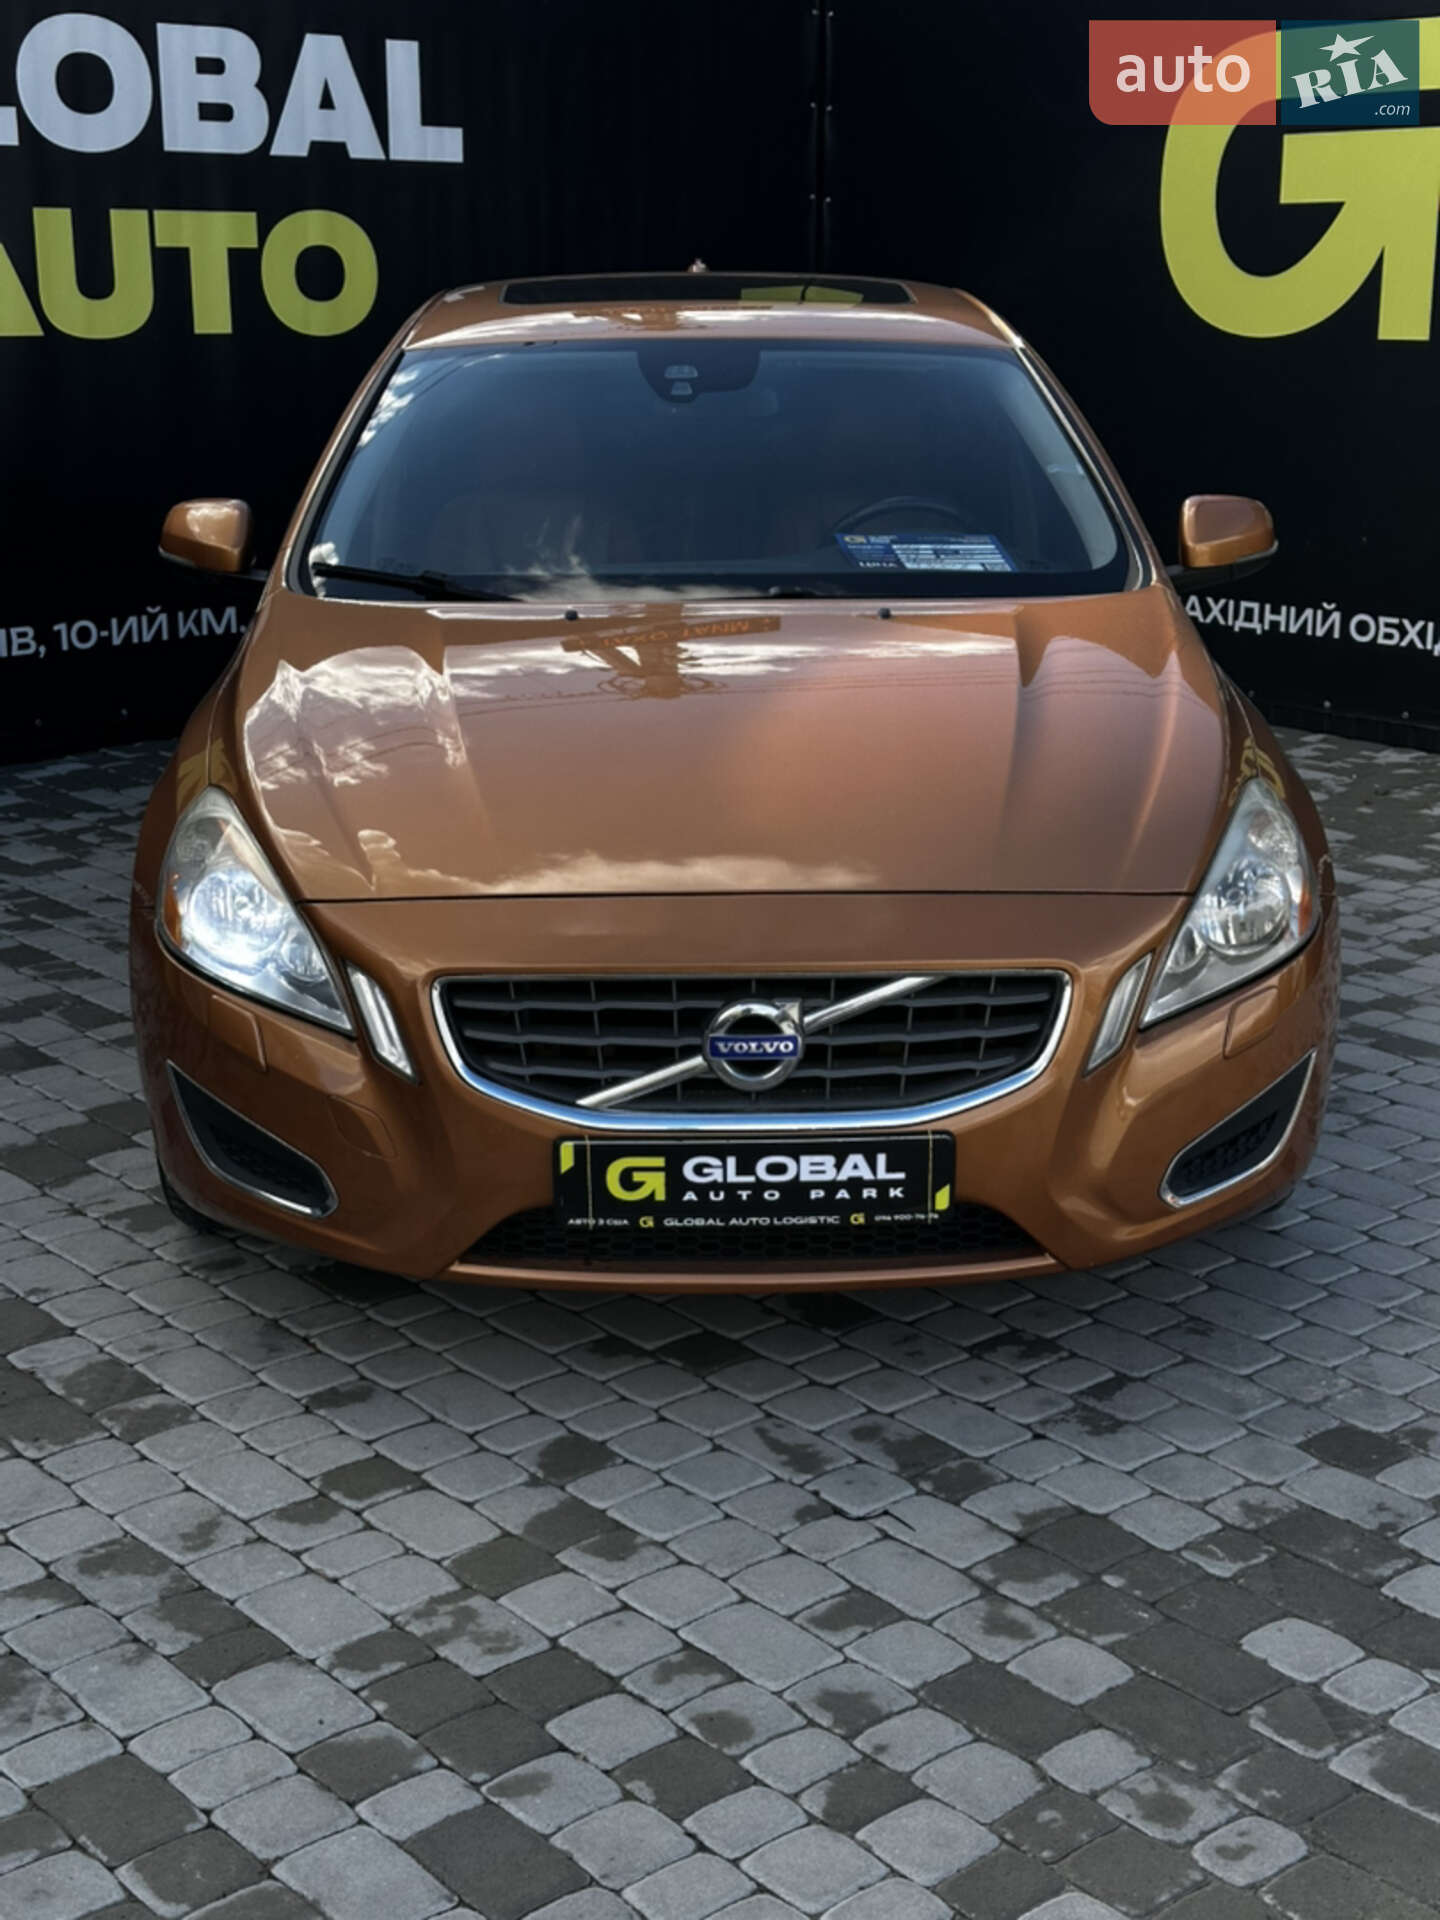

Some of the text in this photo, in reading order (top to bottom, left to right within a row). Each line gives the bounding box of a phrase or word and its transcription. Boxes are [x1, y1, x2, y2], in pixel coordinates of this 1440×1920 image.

[0, 13, 464, 163] OBAL
[177, 606, 249, 639] КМ.
[1349, 613, 1440, 656] ОБХІ
[715, 1041, 794, 1054] VOLVO
[682, 1153, 906, 1184] GLOBAL
[682, 1187, 905, 1201] AUTO PARK
[663, 1215, 841, 1226] GLOBAL AUTO LOGISTIC
